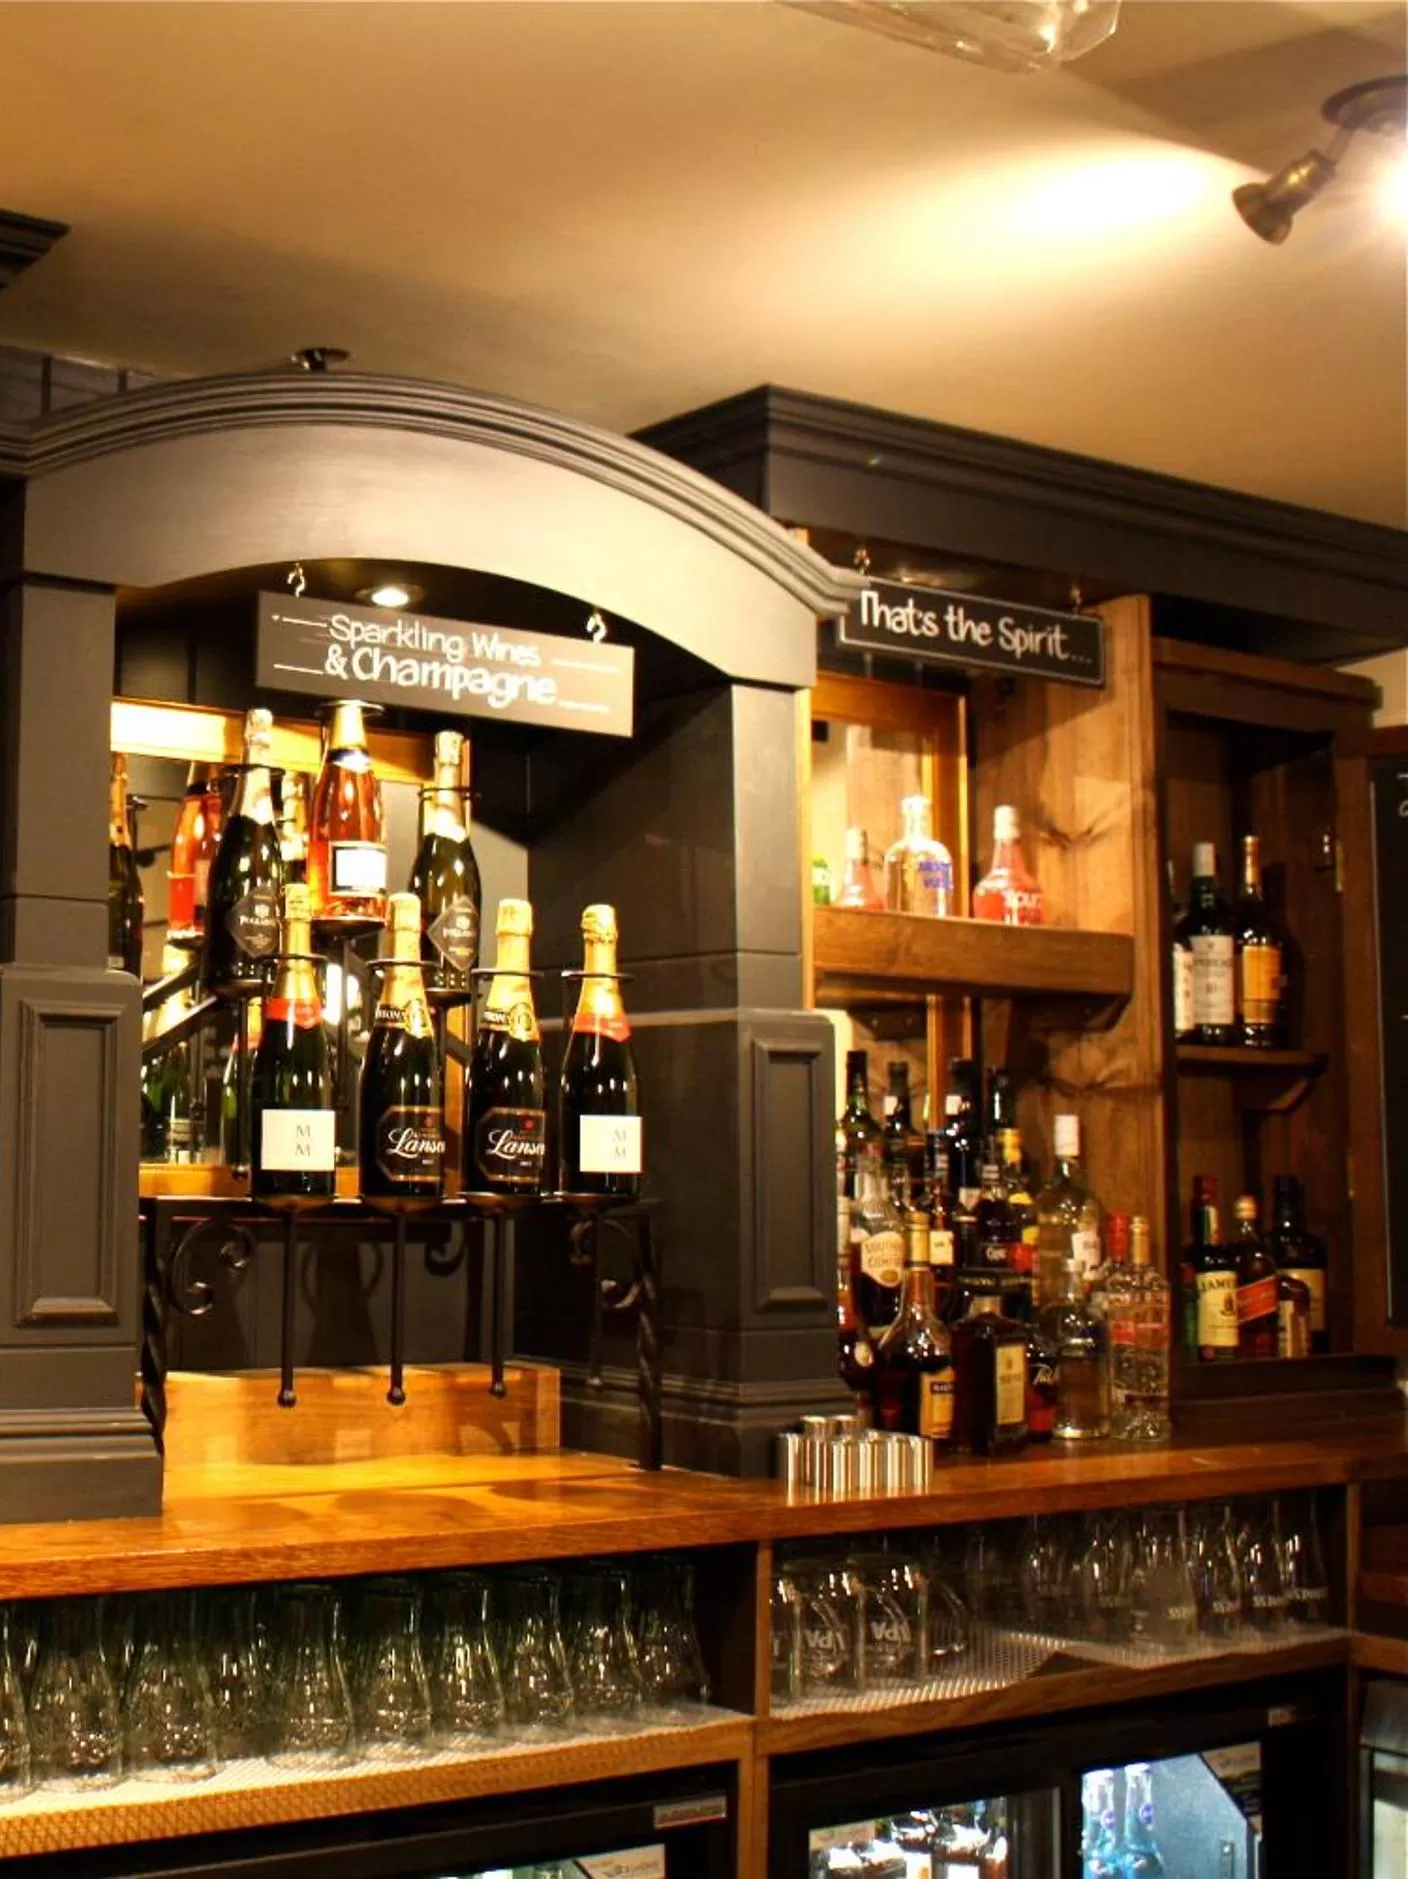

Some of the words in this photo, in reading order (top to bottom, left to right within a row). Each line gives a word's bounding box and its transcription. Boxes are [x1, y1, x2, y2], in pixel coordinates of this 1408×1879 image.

[328, 614, 465, 664] Sparkling
[471, 631, 542, 668] Wines
[943, 604, 993, 647] the
[323, 643, 351, 681] &
[351, 646, 559, 709] Champagne
[387, 1127, 446, 1159] Lanso
[487, 1129, 545, 1160] Lanso
